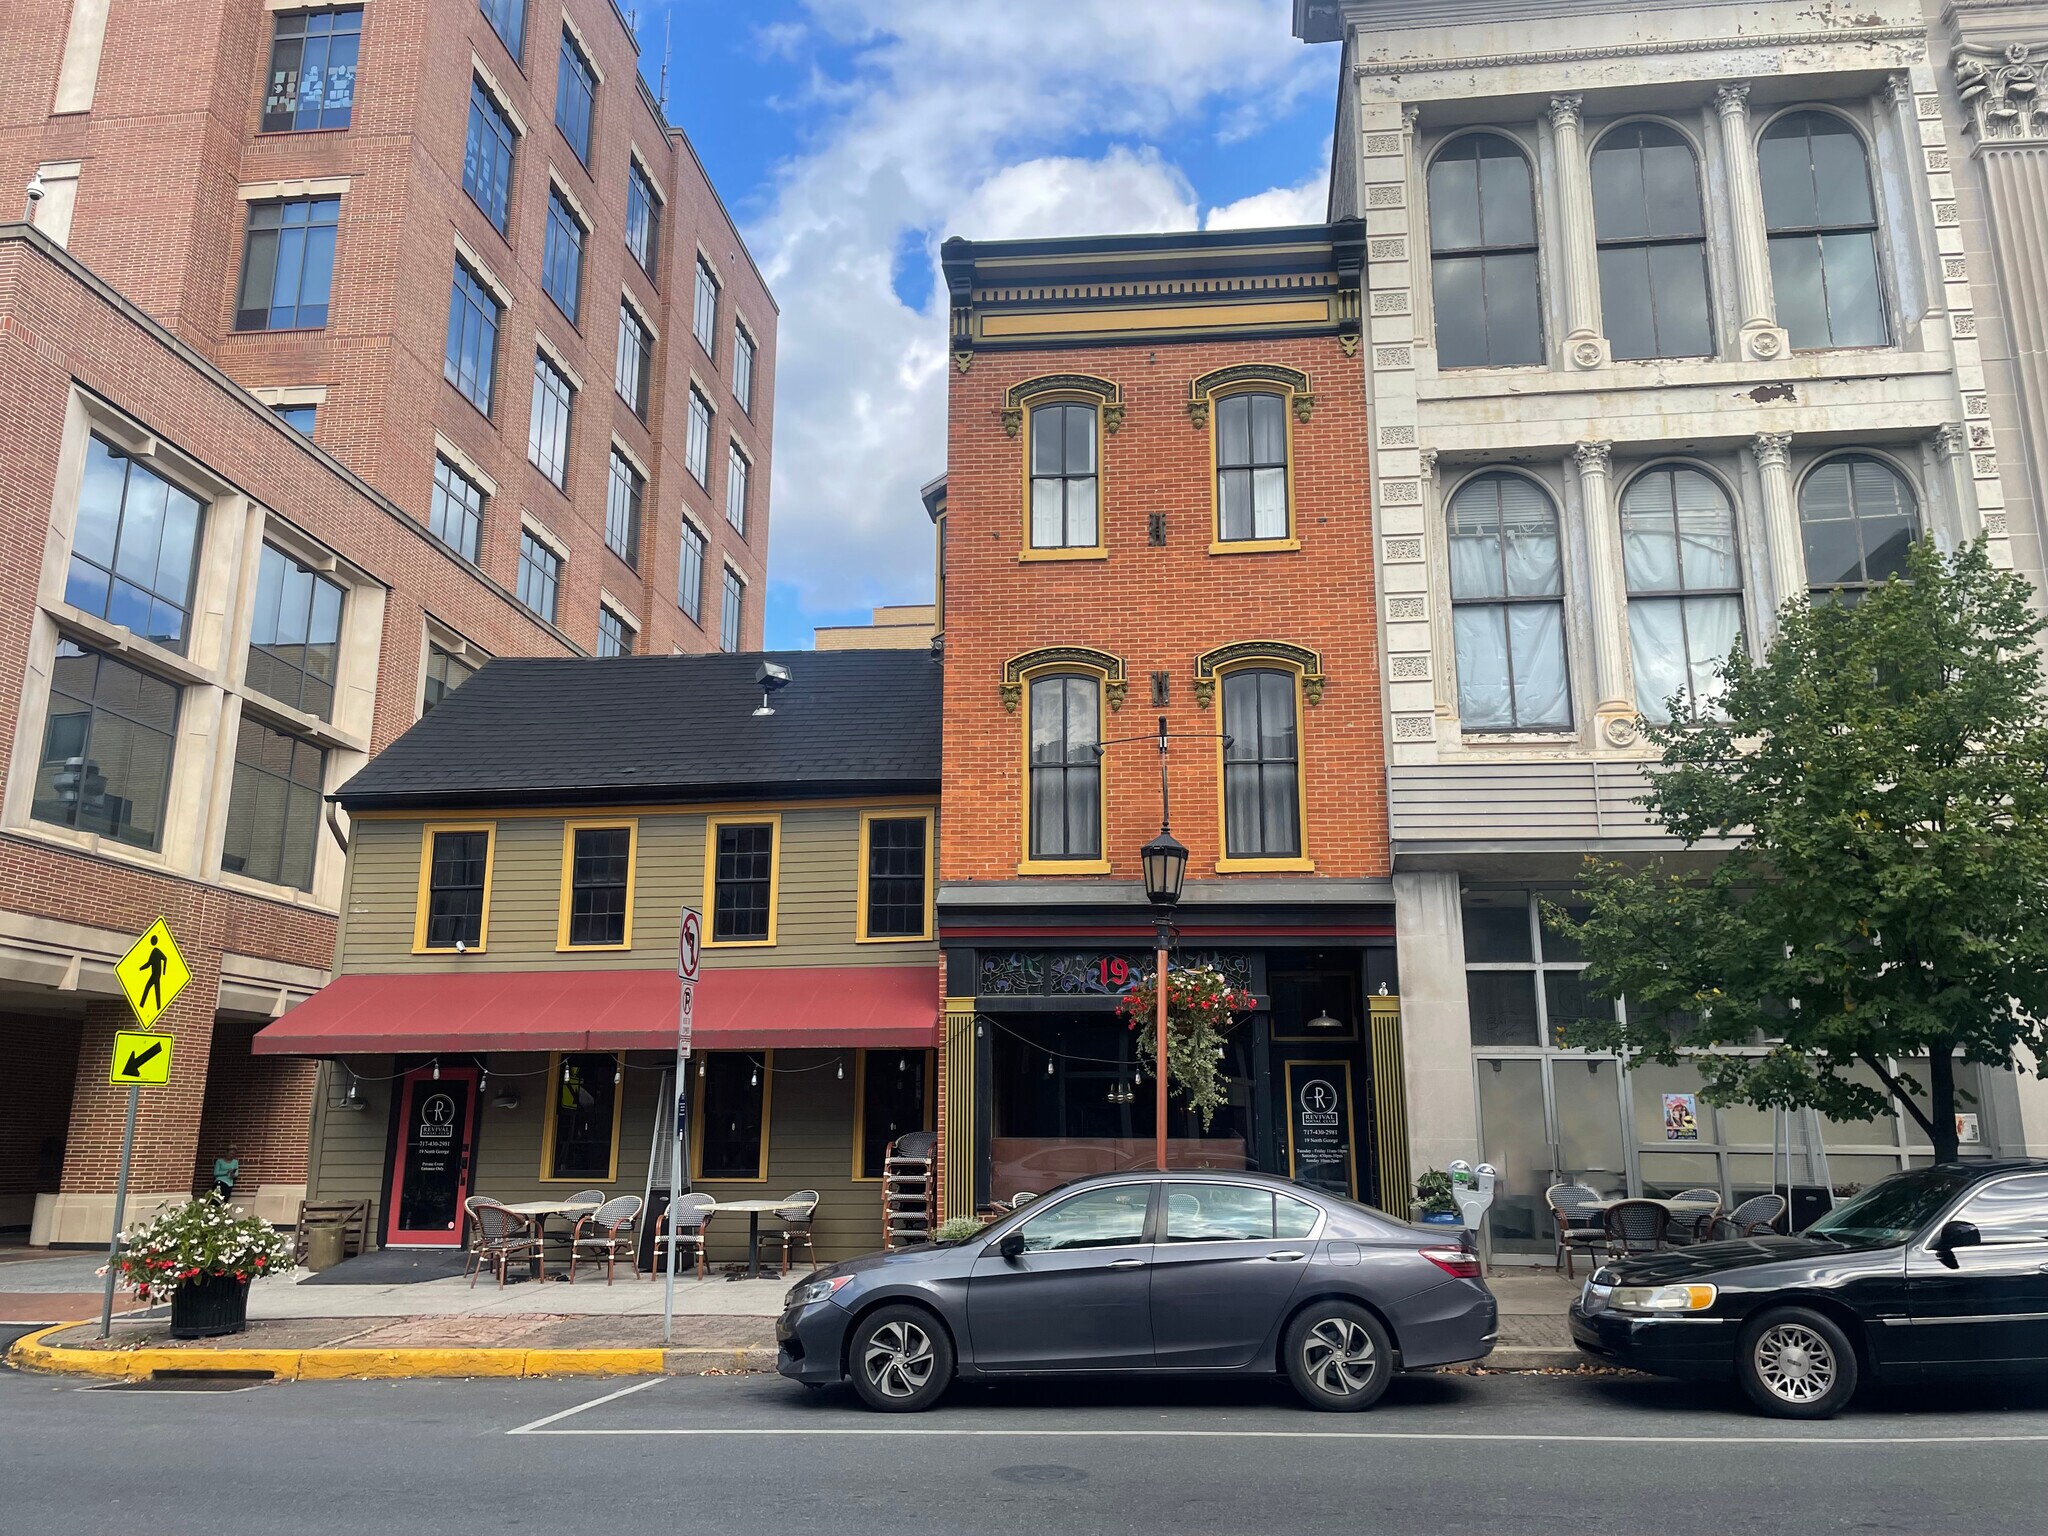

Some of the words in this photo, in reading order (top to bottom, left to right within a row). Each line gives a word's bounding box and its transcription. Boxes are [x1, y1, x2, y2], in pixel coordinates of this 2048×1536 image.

[1100, 958, 1129, 987] 19
[1314, 1087, 1325, 1108] R
[434, 1101, 443, 1121] R
